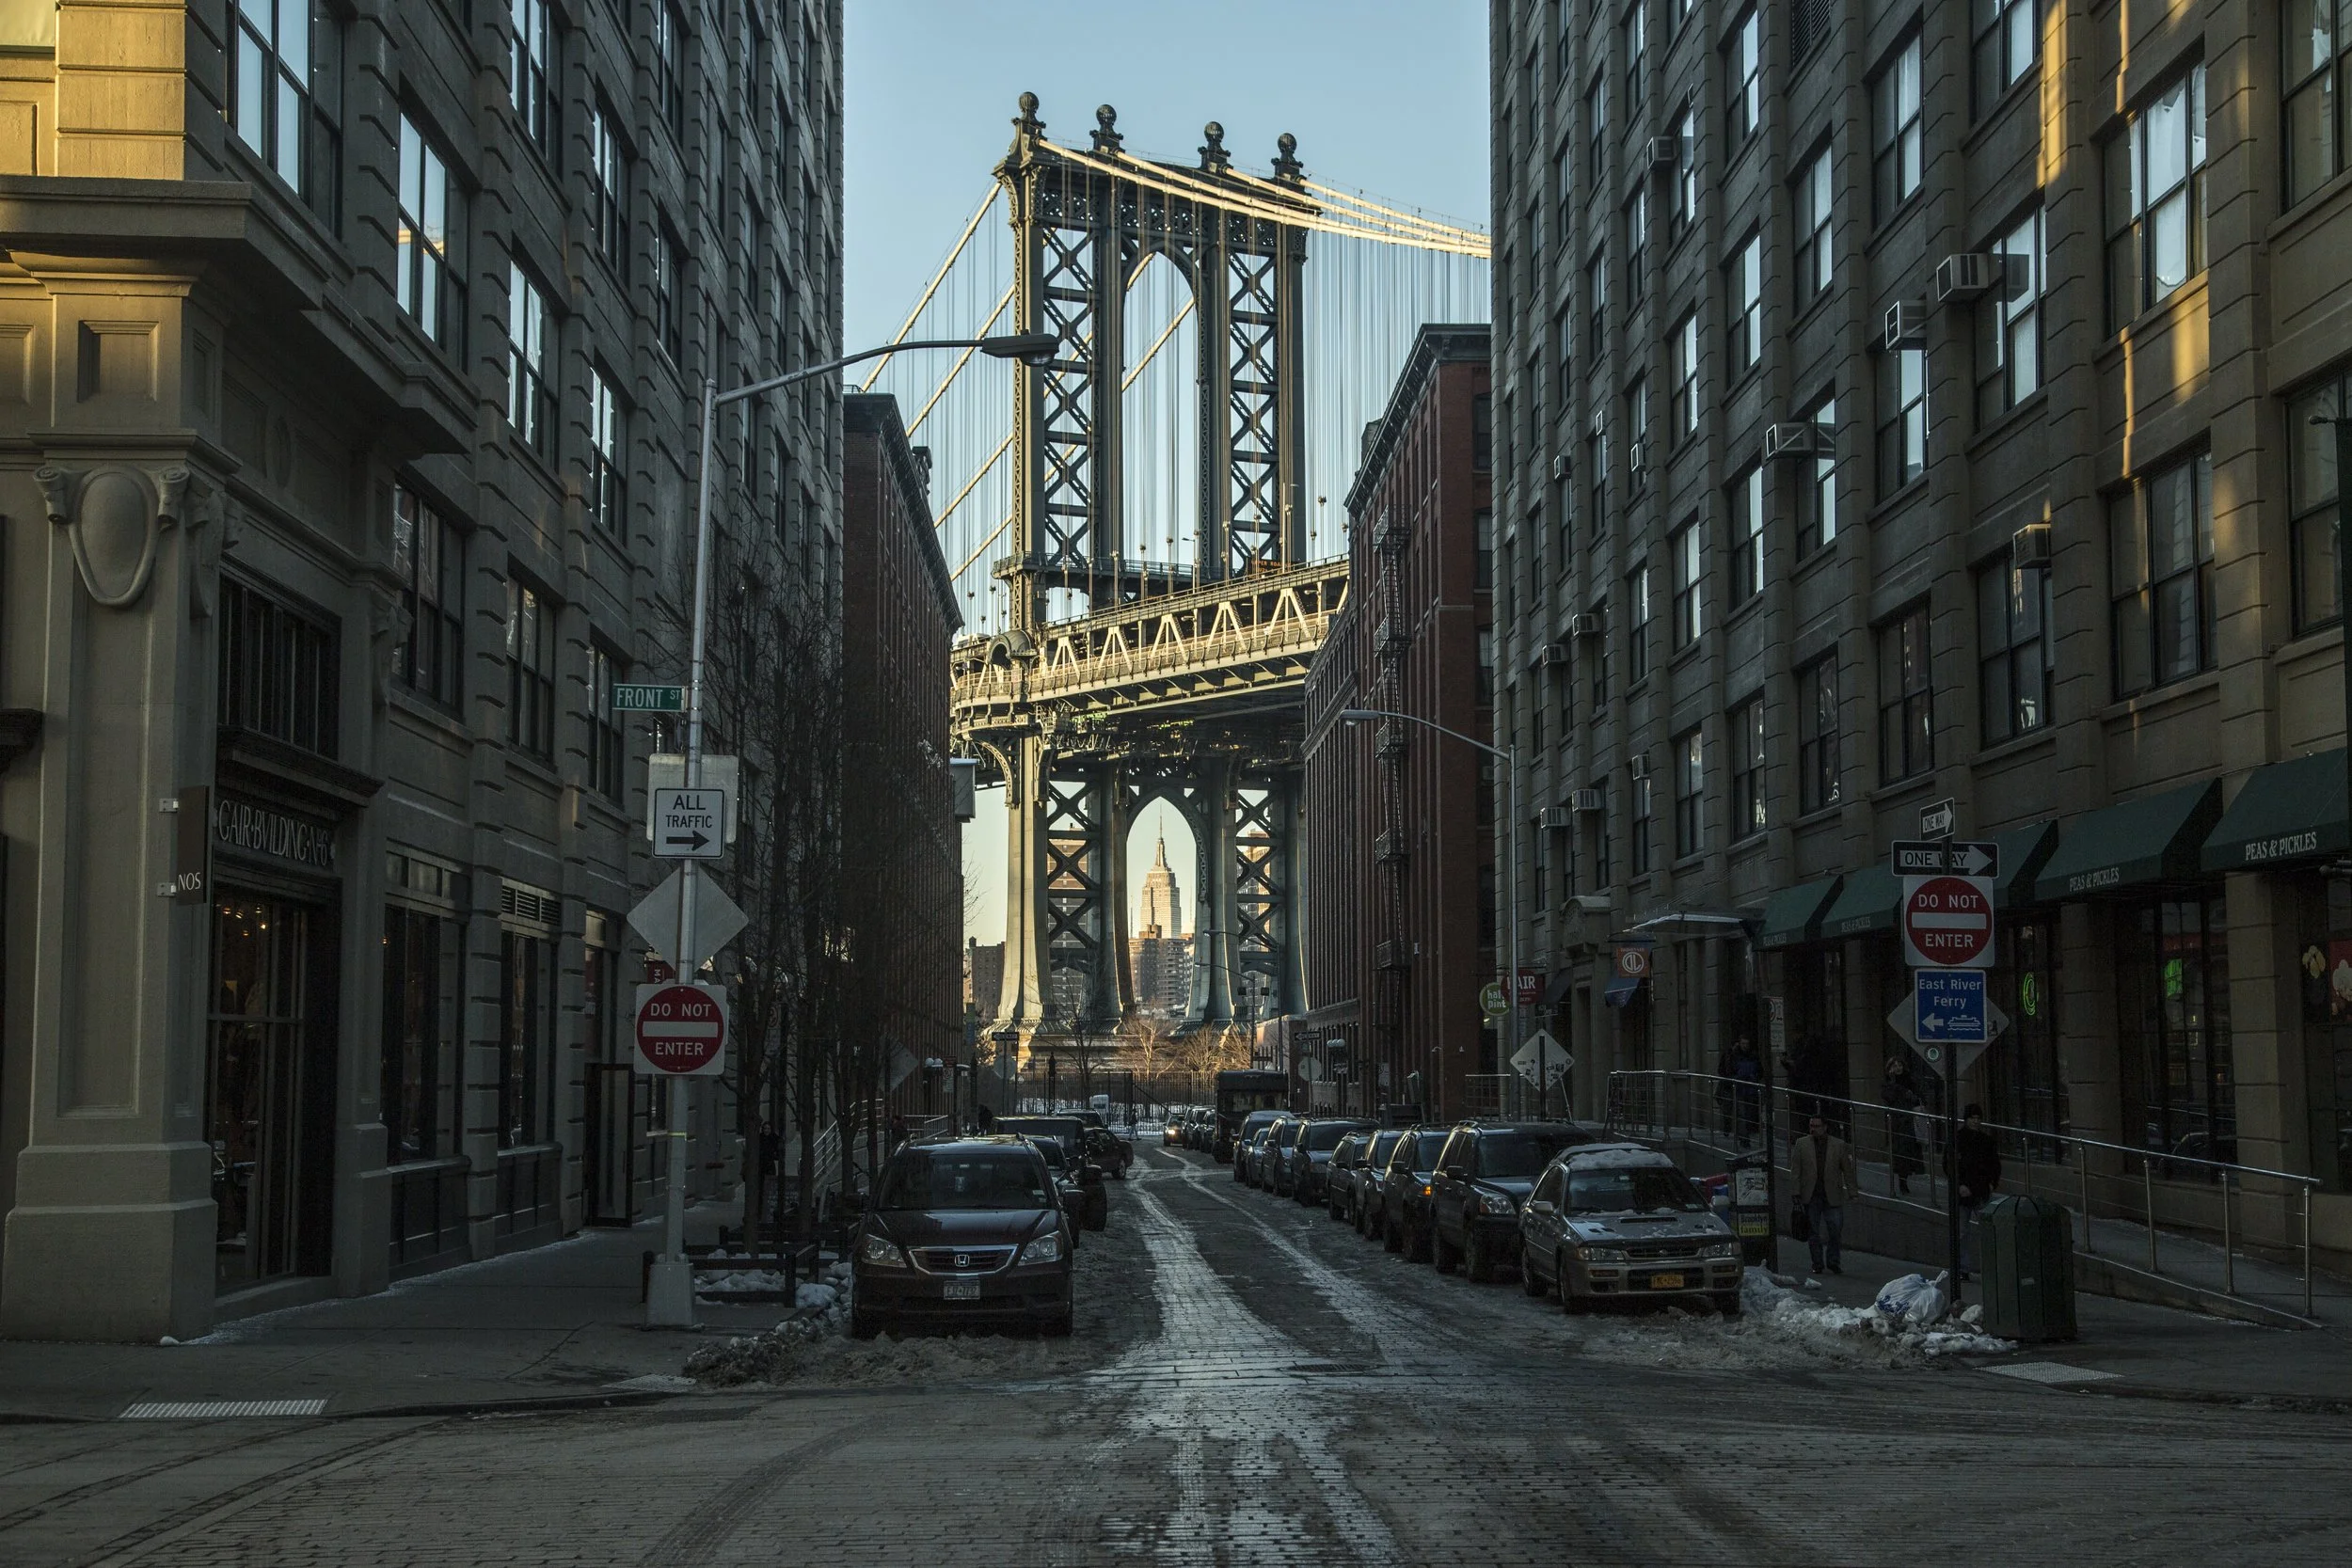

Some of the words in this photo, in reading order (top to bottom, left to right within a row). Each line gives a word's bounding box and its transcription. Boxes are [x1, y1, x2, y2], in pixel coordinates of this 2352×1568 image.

[616, 688, 663, 708] FRONT
[670, 689, 680, 701] ST
[673, 795, 706, 811] ALL
[666, 815, 712, 829] TRAFFIC
[1925, 816, 1934, 832] ONE
[1935, 813, 1945, 829] WAY
[2245, 841, 2267, 862] PEAS
[2269, 840, 2278, 858] &
[2279, 832, 2317, 856] PICKLES
[1905, 852, 1932, 865] ONE
[178, 872, 201, 890] NOS
[2070, 875, 2085, 892] PEAS
[1918, 895, 1938, 908] DO
[1948, 895, 1979, 909] NOT
[1925, 933, 1974, 948] ENTER
[1919, 979, 1945, 990] East
[1950, 978, 1981, 990] River
[1486, 990, 1505, 999] hal
[1487, 999, 1506, 1010] pint
[1933, 996, 1967, 1009] Ferry
[650, 1003, 671, 1017] DO
[681, 1004, 712, 1017] NOT
[655, 1041, 704, 1055] ENTER
